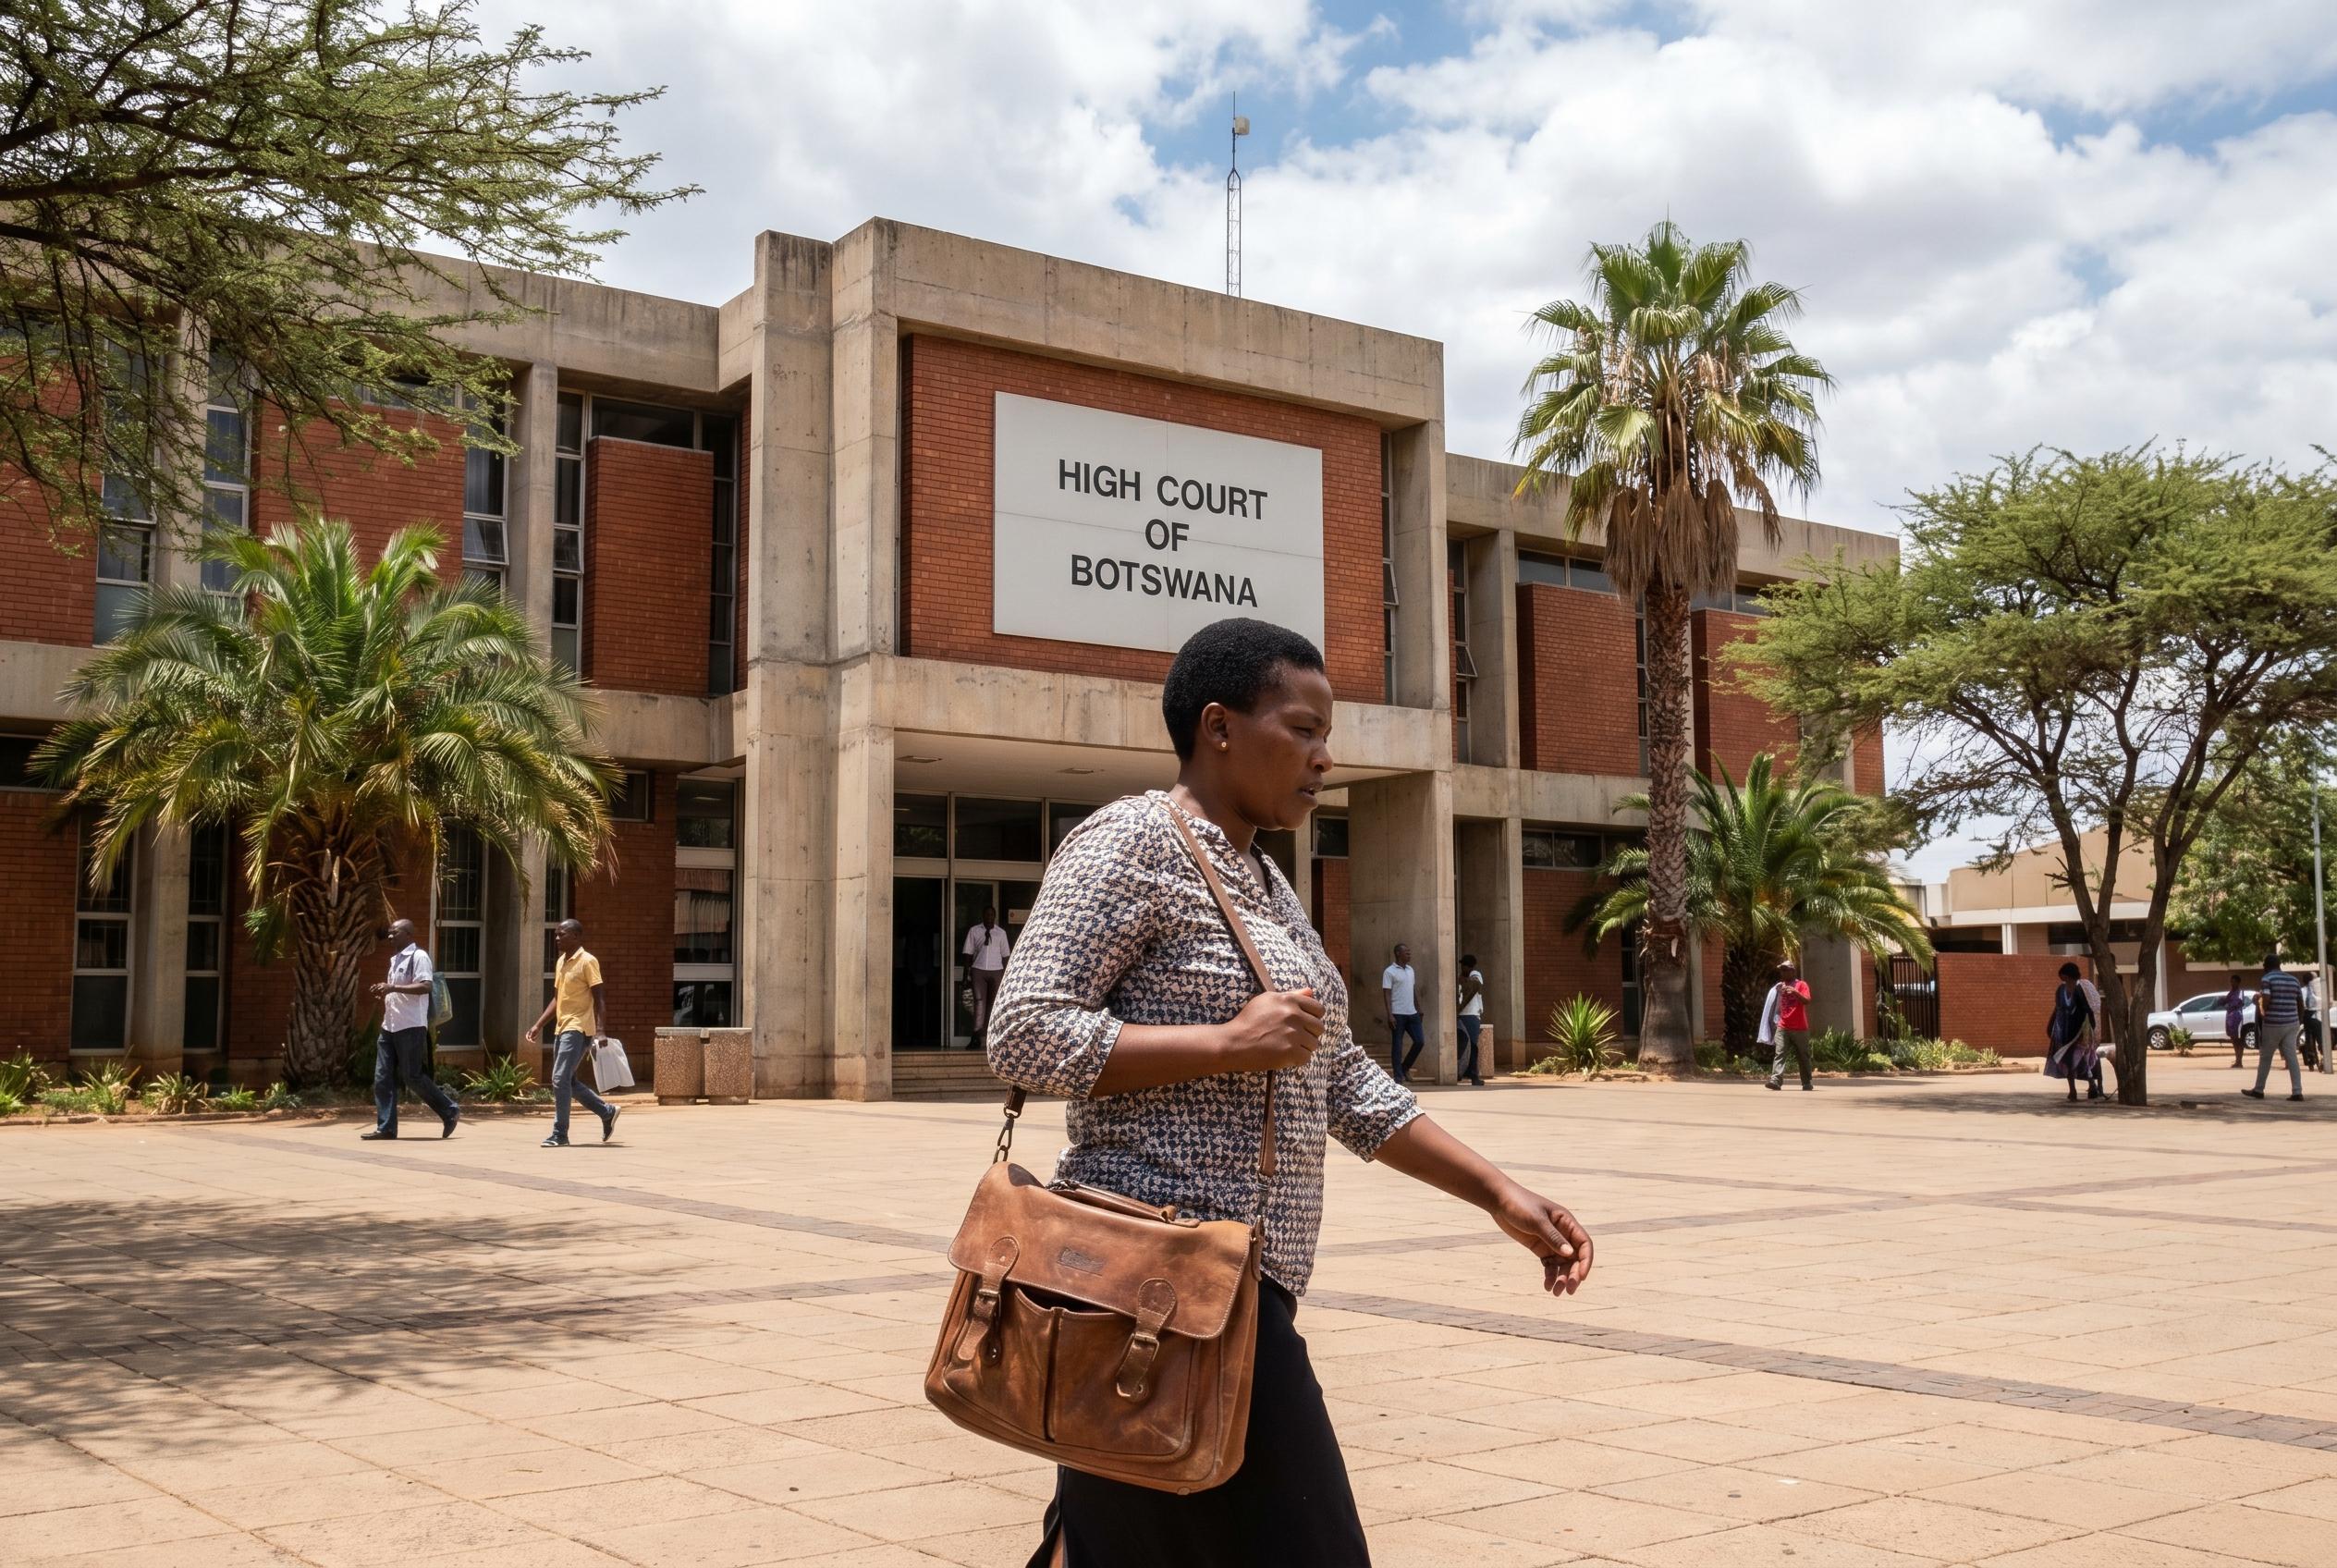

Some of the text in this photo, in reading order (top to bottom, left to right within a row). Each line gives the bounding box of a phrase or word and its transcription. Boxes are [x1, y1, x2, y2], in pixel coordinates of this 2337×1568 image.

[1058, 459, 1268, 521] HIGH COURT
[1144, 518, 1190, 552] OF
[1071, 554, 1258, 608] BOTSWANA
